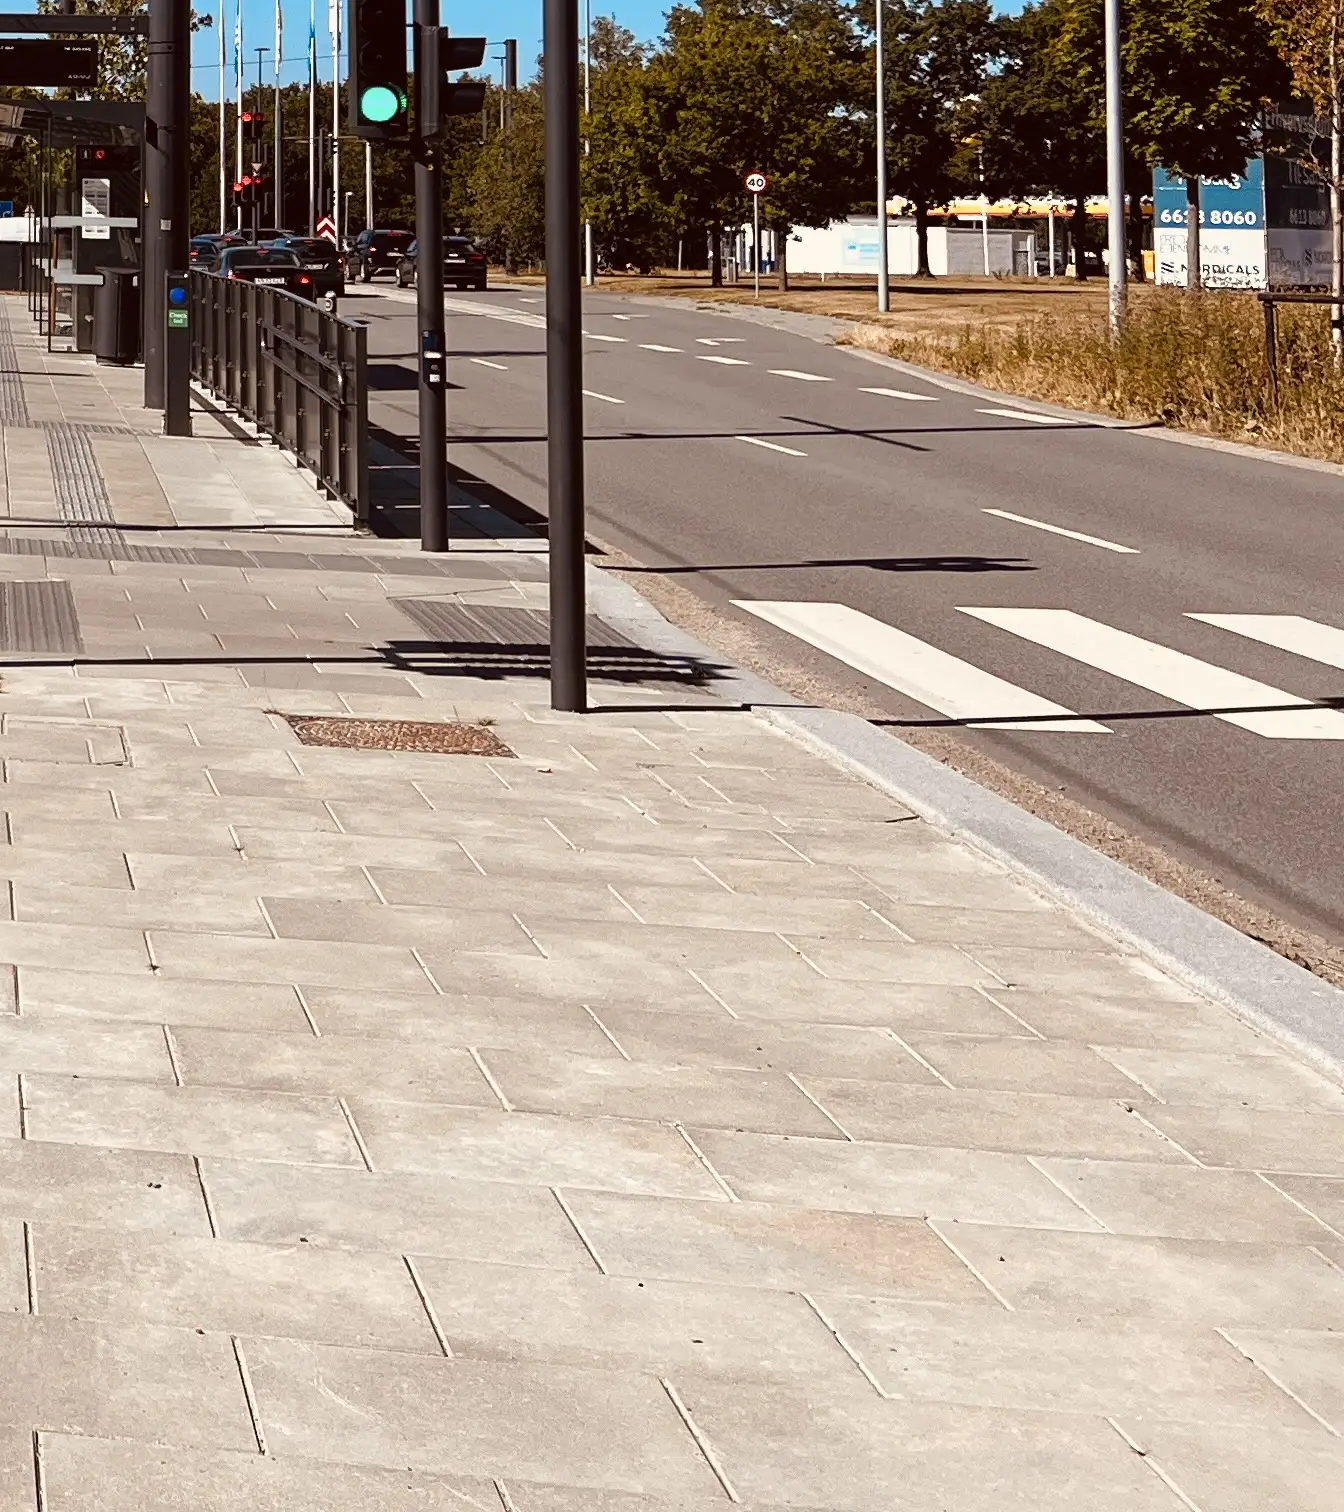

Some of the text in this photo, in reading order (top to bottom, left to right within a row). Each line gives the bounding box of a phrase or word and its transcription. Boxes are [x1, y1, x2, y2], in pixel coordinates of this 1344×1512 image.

[748, 178, 764, 187] 40
[1210, 210, 1257, 226] 8060
[1180, 263, 1260, 276] NRDICALS
